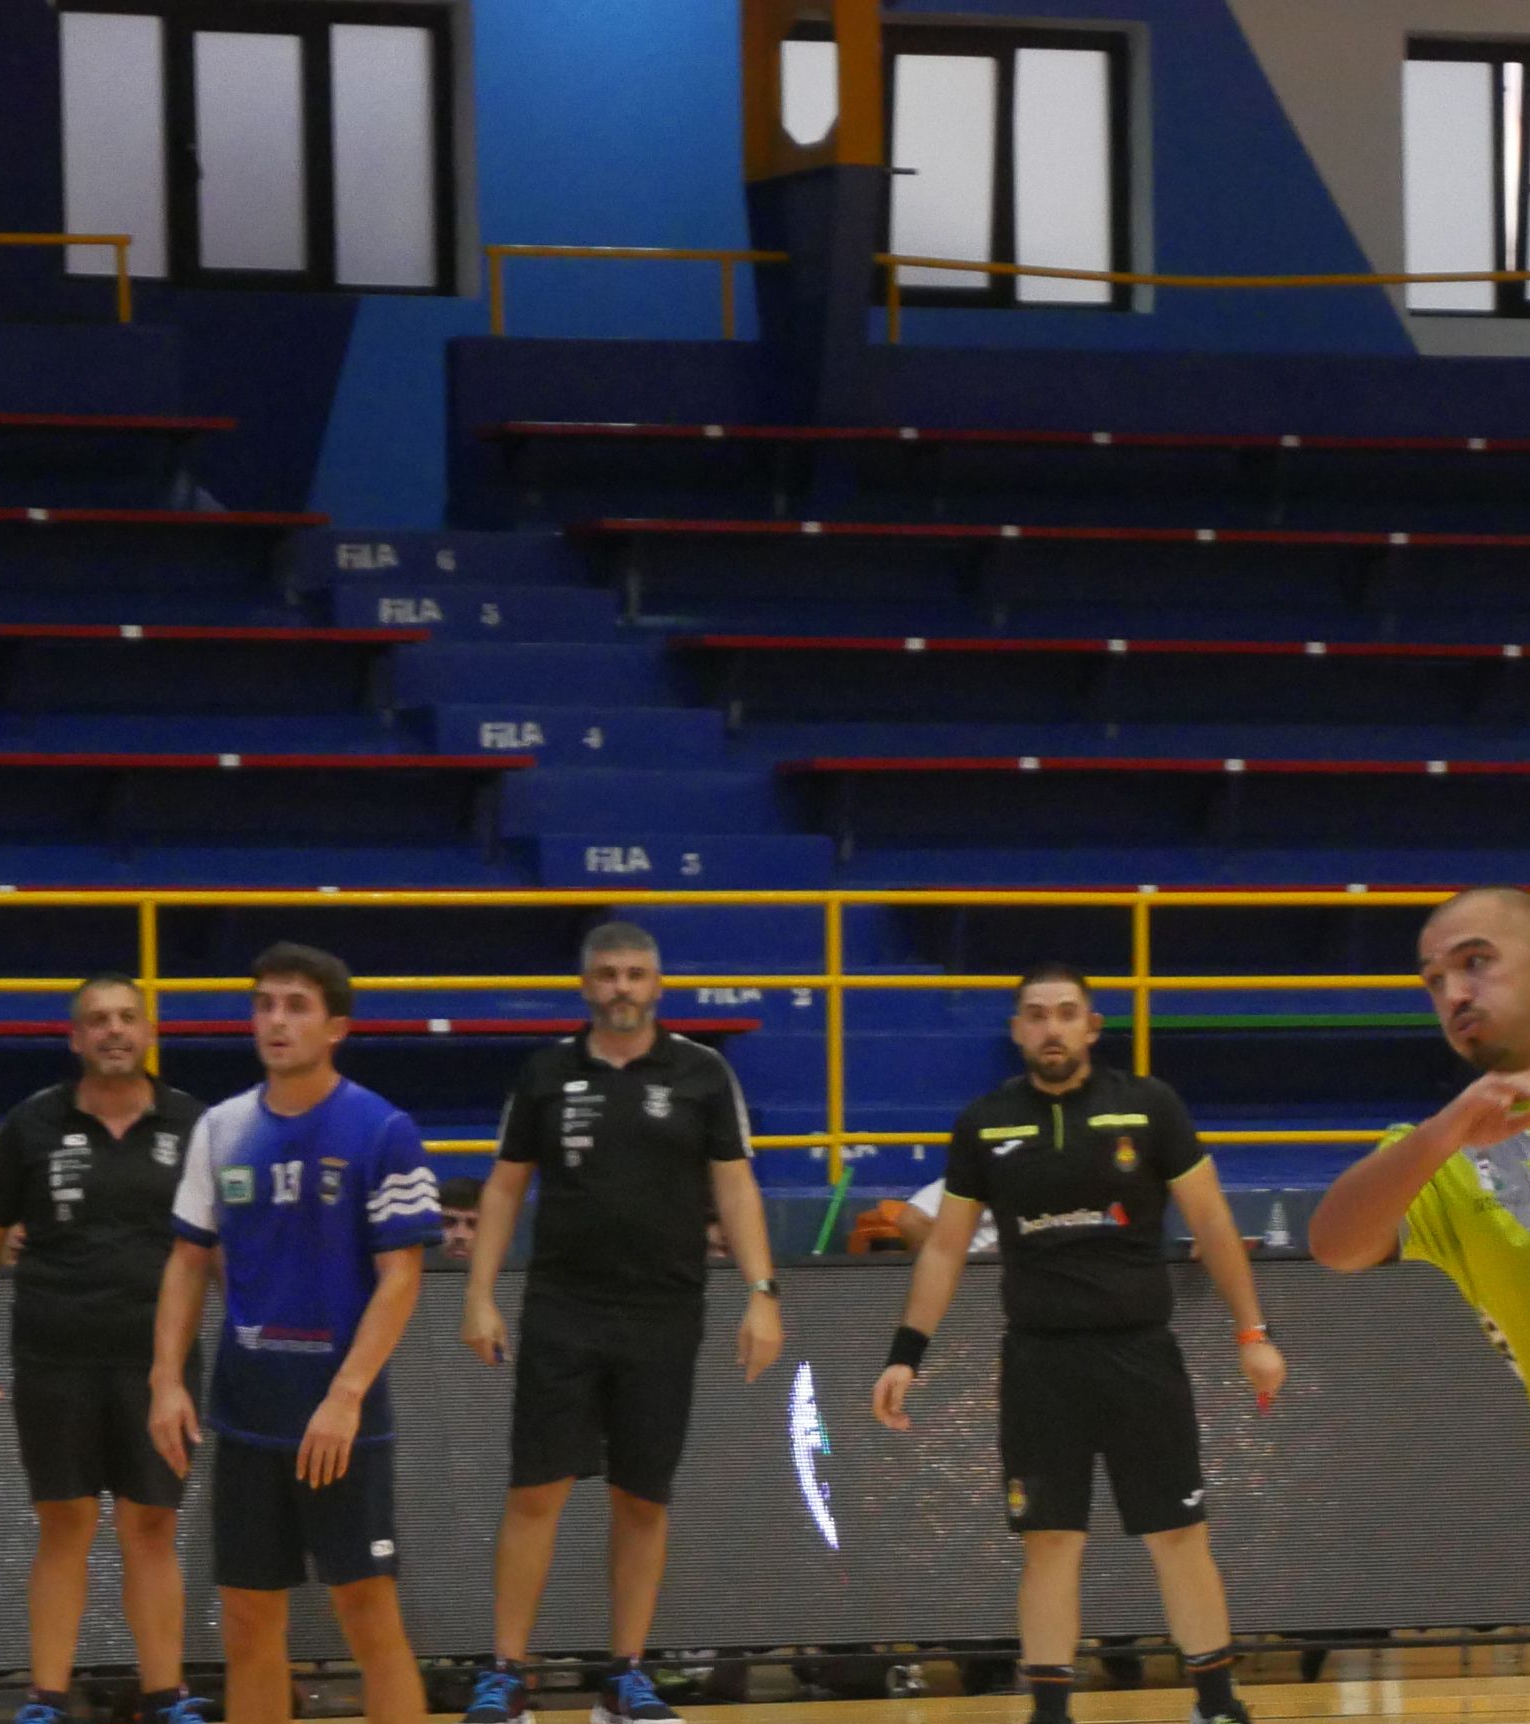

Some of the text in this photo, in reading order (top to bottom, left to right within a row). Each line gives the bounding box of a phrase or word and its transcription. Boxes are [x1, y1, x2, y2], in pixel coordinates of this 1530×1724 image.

[337, 544, 399, 571] FILA
[377, 597, 443, 625] FILA
[479, 721, 546, 749] FILA
[584, 846, 652, 874] FILA
